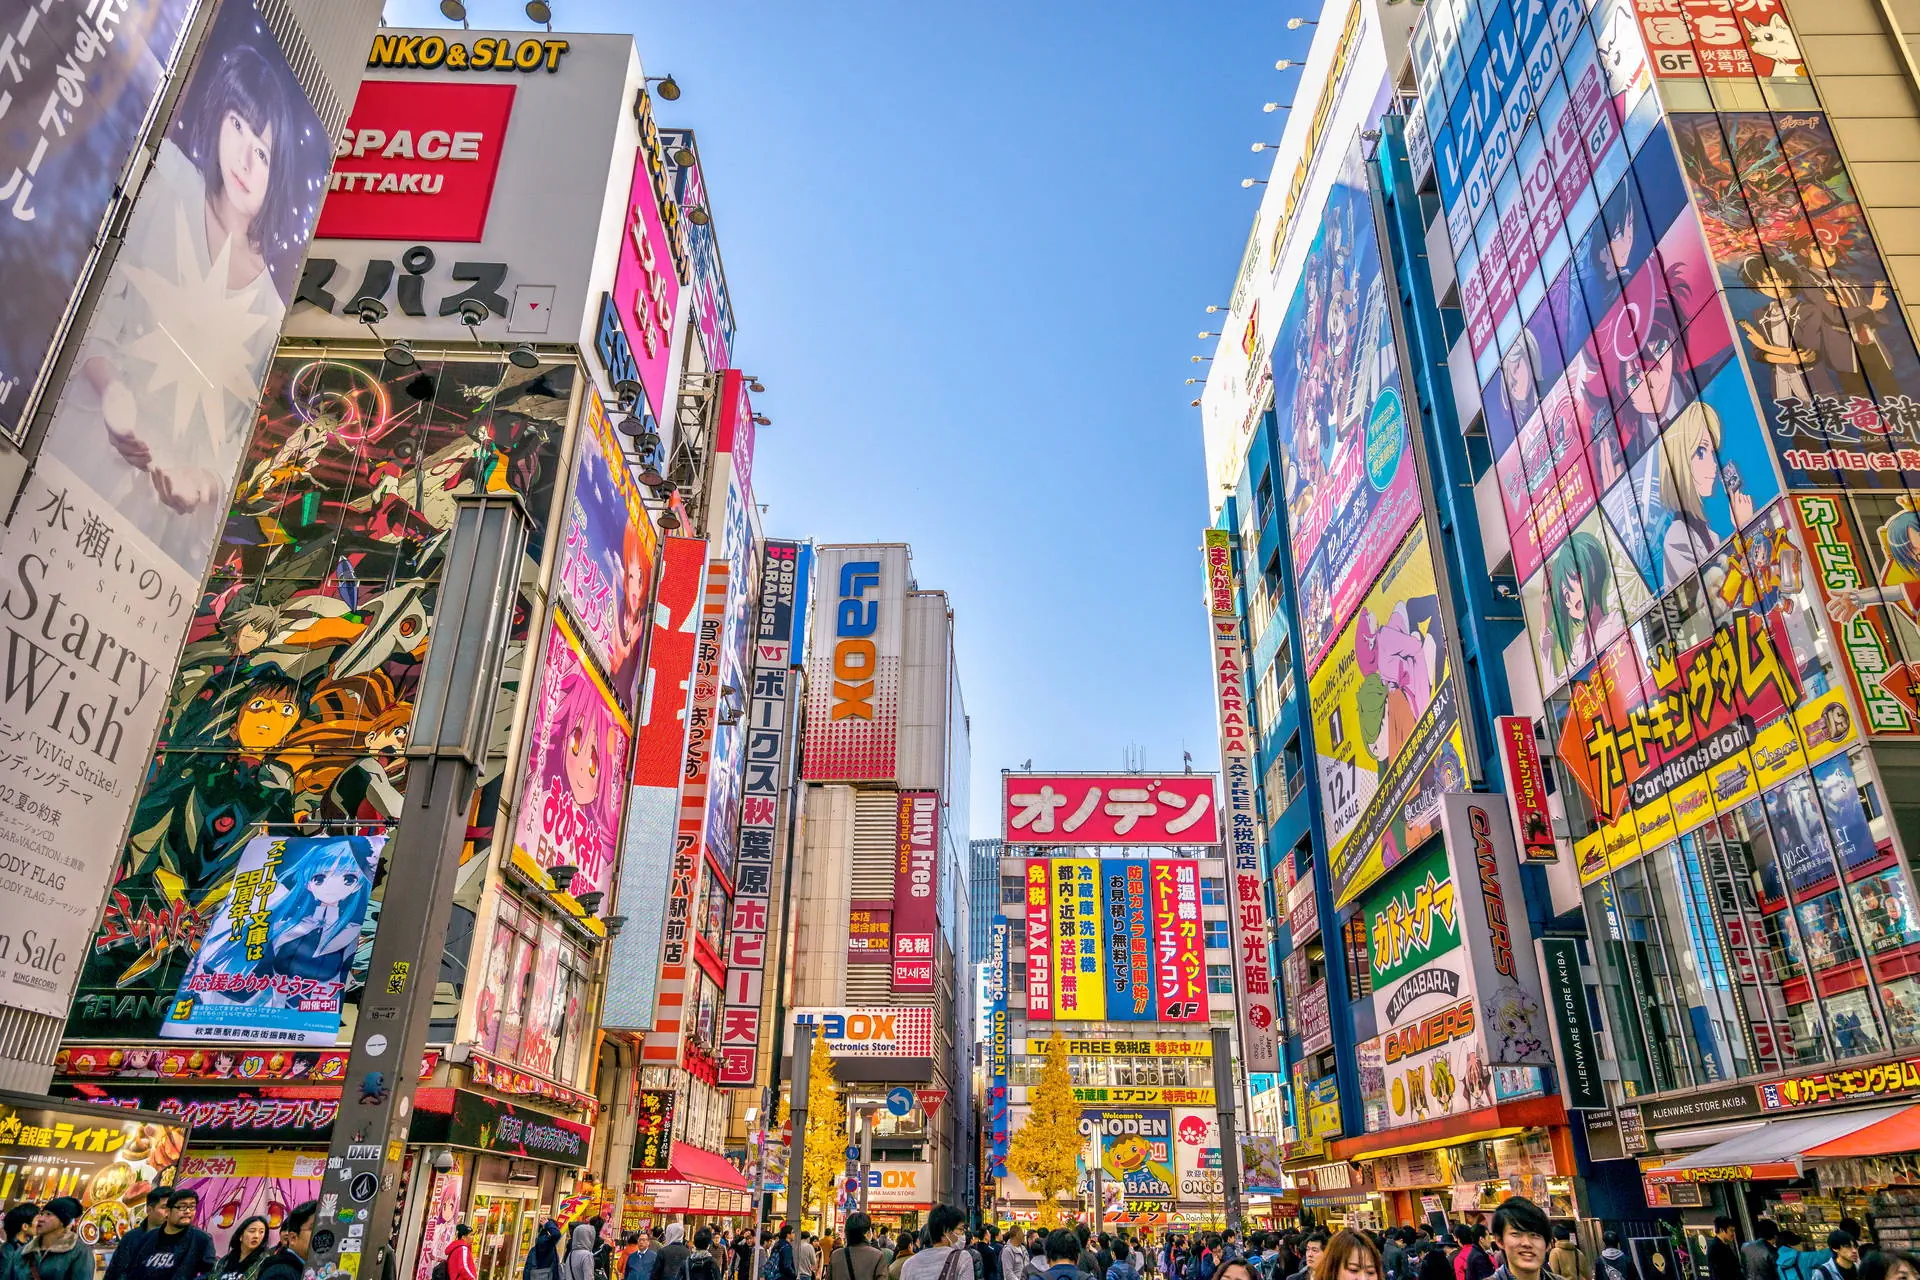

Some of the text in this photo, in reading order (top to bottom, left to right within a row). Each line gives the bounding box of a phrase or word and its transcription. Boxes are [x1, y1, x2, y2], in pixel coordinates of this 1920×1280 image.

[1642, 13, 1744, 46] ぽち
[1700, 49, 1751, 62] 秋葉原
[1660, 53, 1693, 71] 6F
[1703, 61, 1754, 73] 2号店
[336, 128, 485, 161] SPACE
[1590, 113, 1610, 156] 6F
[329, 170, 445, 195] ITTAKU
[37, 487, 183, 618] 水瀬いのり
[778, 546, 796, 607] HOBBY
[1208, 545, 1233, 611] まんが喫茶
[28, 527, 170, 645] New Single
[759, 545, 780, 636] PARADISE
[1799, 496, 1909, 732] カードゲム専門店
[1, 552, 163, 717] Starry
[1338, 648, 1356, 676] Nine
[4, 625, 124, 765] Wish
[1219, 646, 1247, 752] TAKARADA
[1587, 610, 1799, 821] カードキングダム
[1327, 754, 1357, 816] 12.7
[1513, 731, 1537, 809] カードキングダム
[1633, 721, 1752, 805] cardkingdom
[899, 797, 913, 874] Flagship Store
[1010, 779, 1211, 836] オノデン
[1333, 800, 1360, 836] ON SALE
[911, 797, 936, 898] Duty Free
[1232, 813, 1257, 870] 免税商店
[32, 866, 67, 892] FLAG
[228, 870, 263, 943] 28周年!!
[246, 840, 287, 962] スニーカー文庫は
[662, 834, 696, 967] アキバ駅前店
[1467, 804, 1519, 985] GAMERS
[849, 922, 890, 933] 総合家電
[850, 911, 871, 922] 本店
[1028, 864, 1049, 1011] 免税 TAX FREE
[1057, 865, 1078, 1012] 都内・近郊送料無料
[1076, 865, 1097, 973] 冷蔵庫洗濯機
[1110, 875, 1129, 993] お見積り無料です
[1127, 866, 1150, 1014] 防犯カメラ販売開始!!
[1155, 865, 1180, 999] ストーブエアコン
[15, 928, 67, 976] Sale
[896, 966, 931, 979] 면세점
[898, 937, 930, 954] 免税
[993, 924, 1006, 1001] Panasonic
[187, 971, 346, 999] 応援ありがとうフェア
[299, 1000, 336, 1012] 開催中!!
[1165, 1002, 1199, 1019] 4F
[1391, 968, 1452, 1018] AKIHABARA
[194, 1027, 307, 1042] 秋葉原駅前商店街振興組合
[872, 1042, 896, 1052] Store
[995, 1010, 1007, 1076] ONODEN
[1070, 1041, 1111, 1054] FREE
[1114, 1041, 1151, 1054] 免税店
[1384, 999, 1476, 1065] GAMERS
[1557, 950, 1591, 1096] ALIENWARE STORE AKIBA
[921, 1095, 941, 1103] 止まれ
[1072, 1088, 1109, 1101] 冷蔵庫
[1113, 1089, 1158, 1101] エアコン
[1652, 1096, 1747, 1119] ALIENWARE STORE AKIBA
[1799, 1062, 1920, 1102] カードキングダム
[18, 1121, 126, 1153] 銀座ライオン
[1102, 1112, 1143, 1120] Welcome to
[1587, 1110, 1613, 1121] ALIENWARE
[348, 1145, 382, 1159] DAVE
